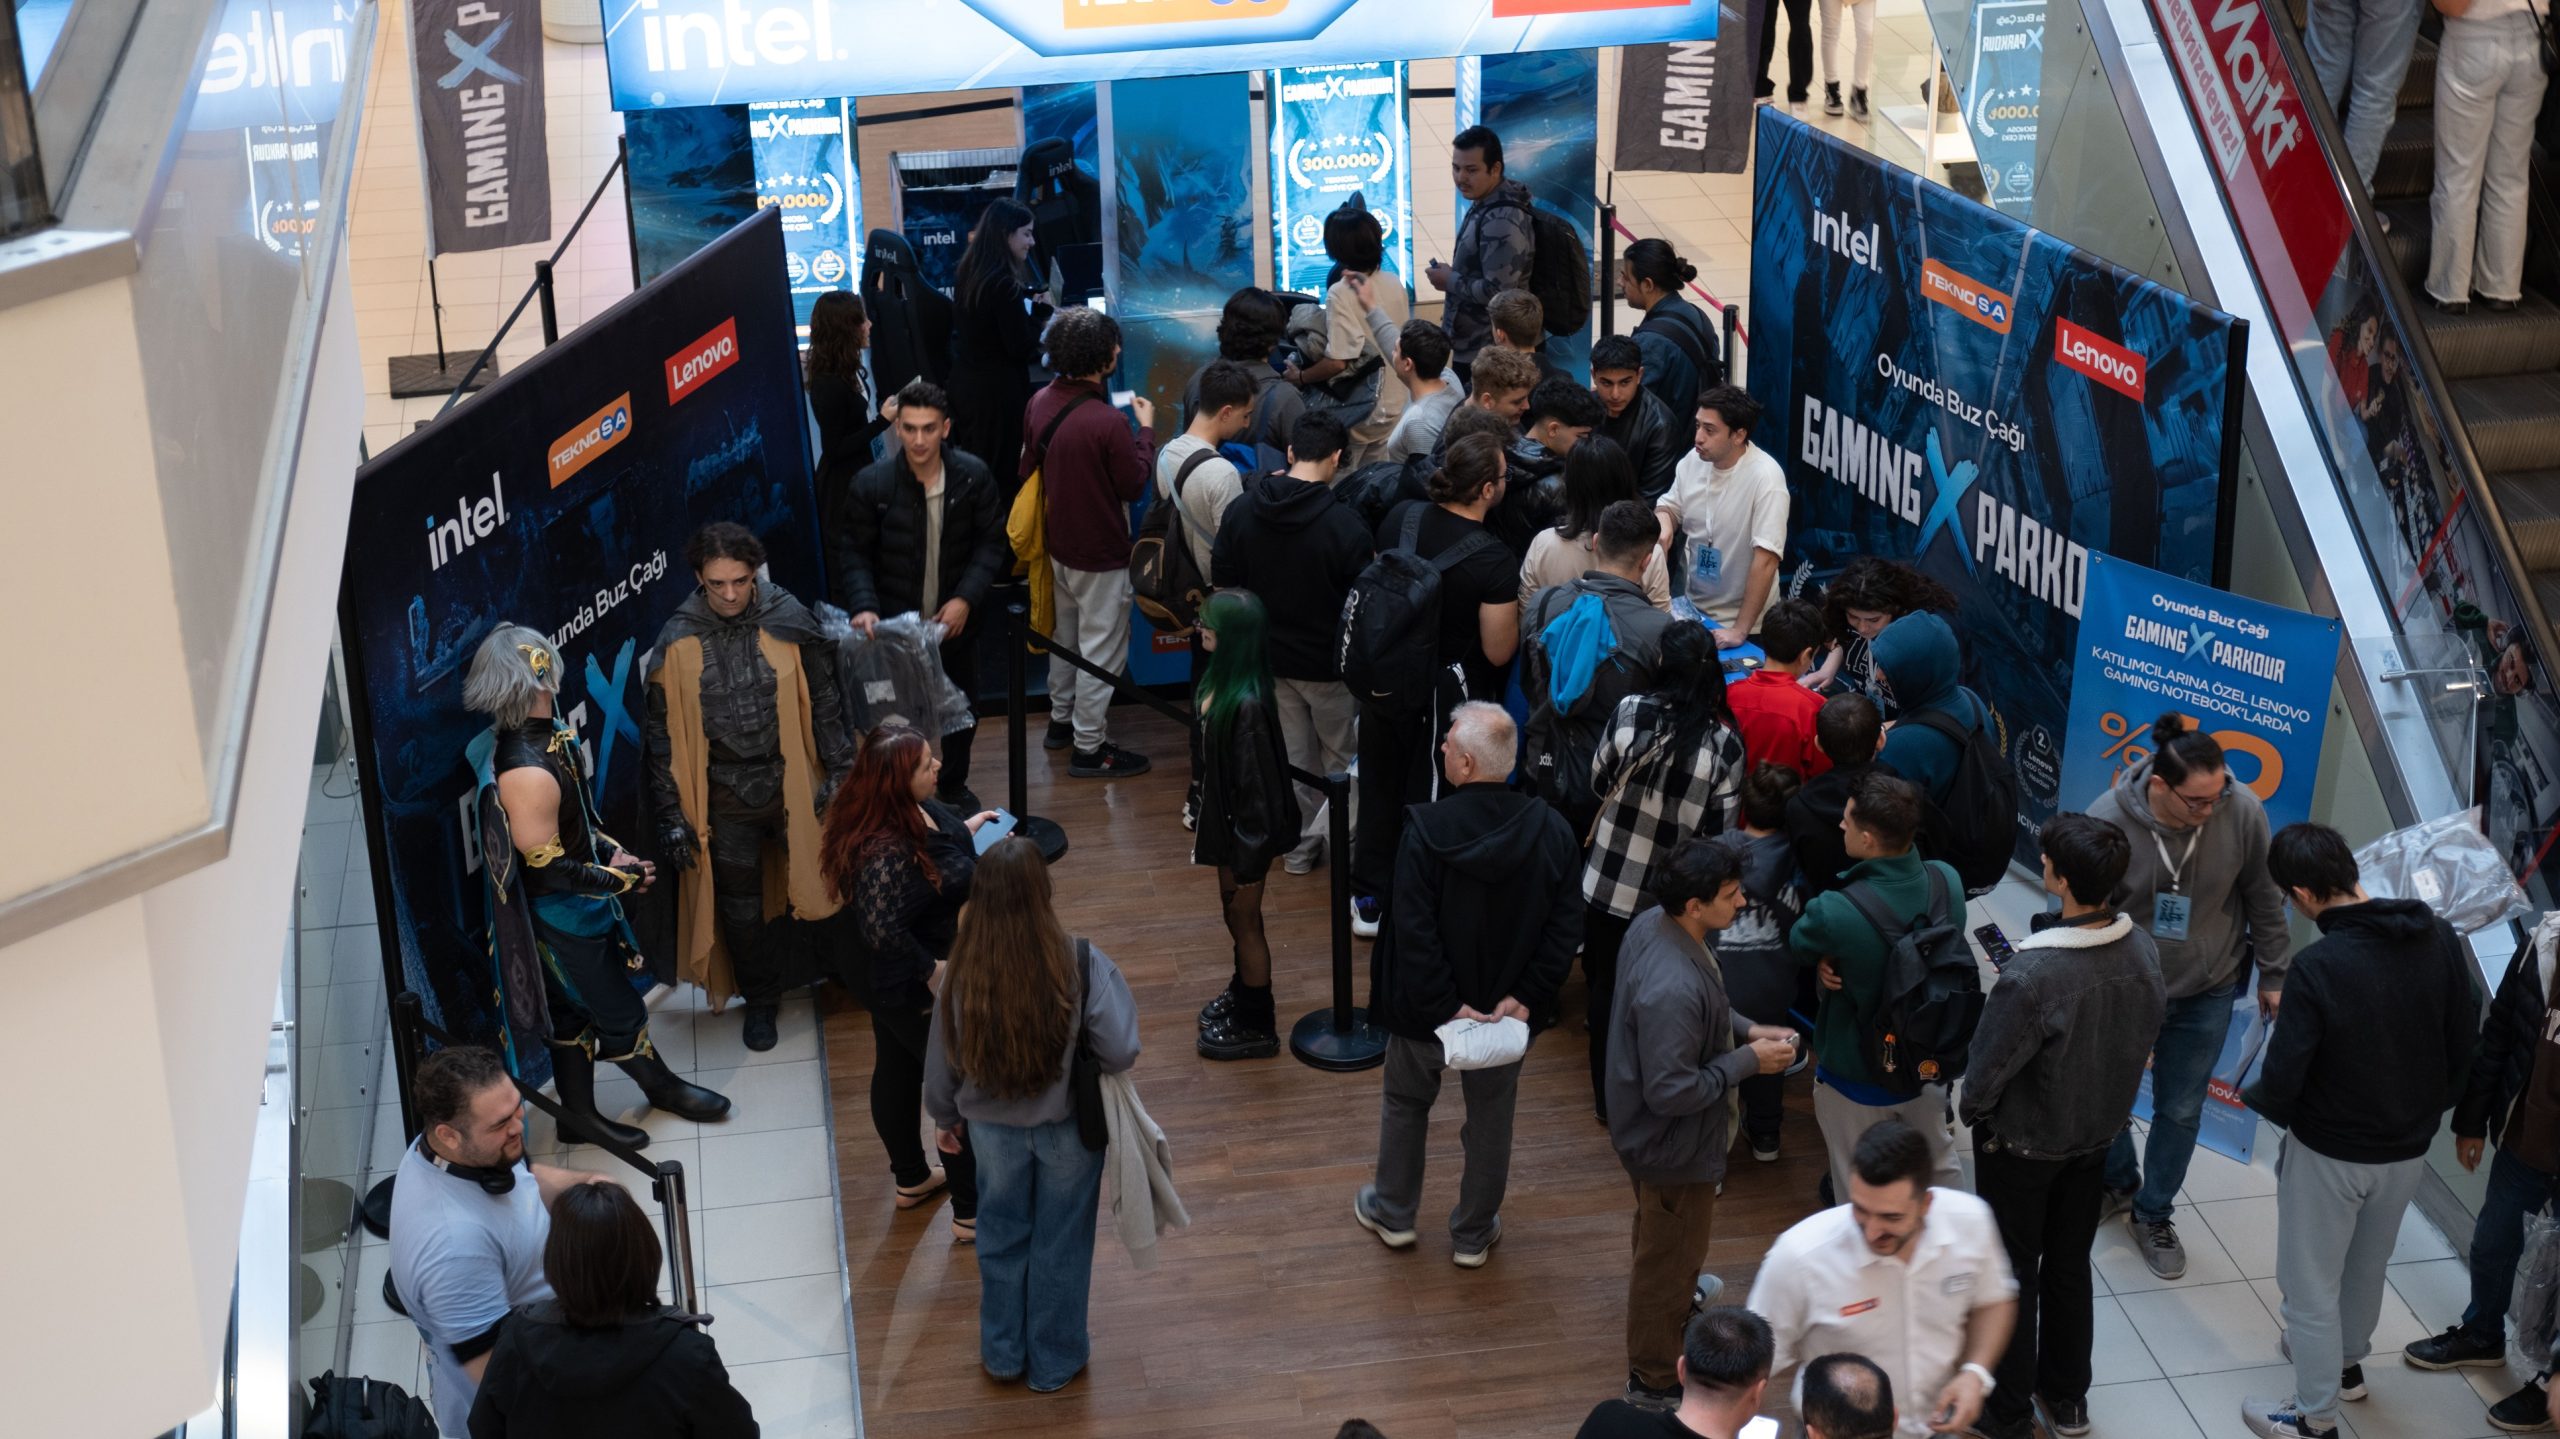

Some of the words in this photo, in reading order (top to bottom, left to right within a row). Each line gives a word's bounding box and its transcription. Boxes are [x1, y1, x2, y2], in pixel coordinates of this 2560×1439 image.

[1660, 40, 1717, 150] GAMIN
[459, 84, 509, 228] GAMING
[1048, 158, 1073, 177] intel
[874, 246, 898, 264] intel
[1926, 269, 2007, 322] TEKNOSA
[673, 334, 735, 390] Lenovo
[2063, 329, 2138, 387] Lenovo
[1878, 352, 1945, 408] Oyunda
[1947, 388, 1981, 428] Buz
[1985, 410, 2026, 452] Çağı
[551, 406, 628, 471] TEKNOSA
[1801, 394, 1923, 527] GAMING
[1977, 490, 2089, 621] PARKO
[595, 579, 629, 617] Buz
[629, 548, 668, 593] Çağı
[2152, 594, 2206, 622] Oyunda
[2208, 610, 2235, 629] Buz
[2237, 618, 2269, 639] Çağı
[2125, 615, 2189, 654] GAMING
[2212, 640, 2286, 684] PARKOUR
[2092, 646, 2210, 693] KATILIMCILARINA
[2212, 681, 2248, 705] ÖZEL
[2251, 694, 2311, 723] LENOVO
[2104, 666, 2160, 693] GAMING
[2028, 751, 2054, 773] Lenovo
[2038, 732, 2047, 749] 2.
[2207, 1083, 2241, 1103] novo
